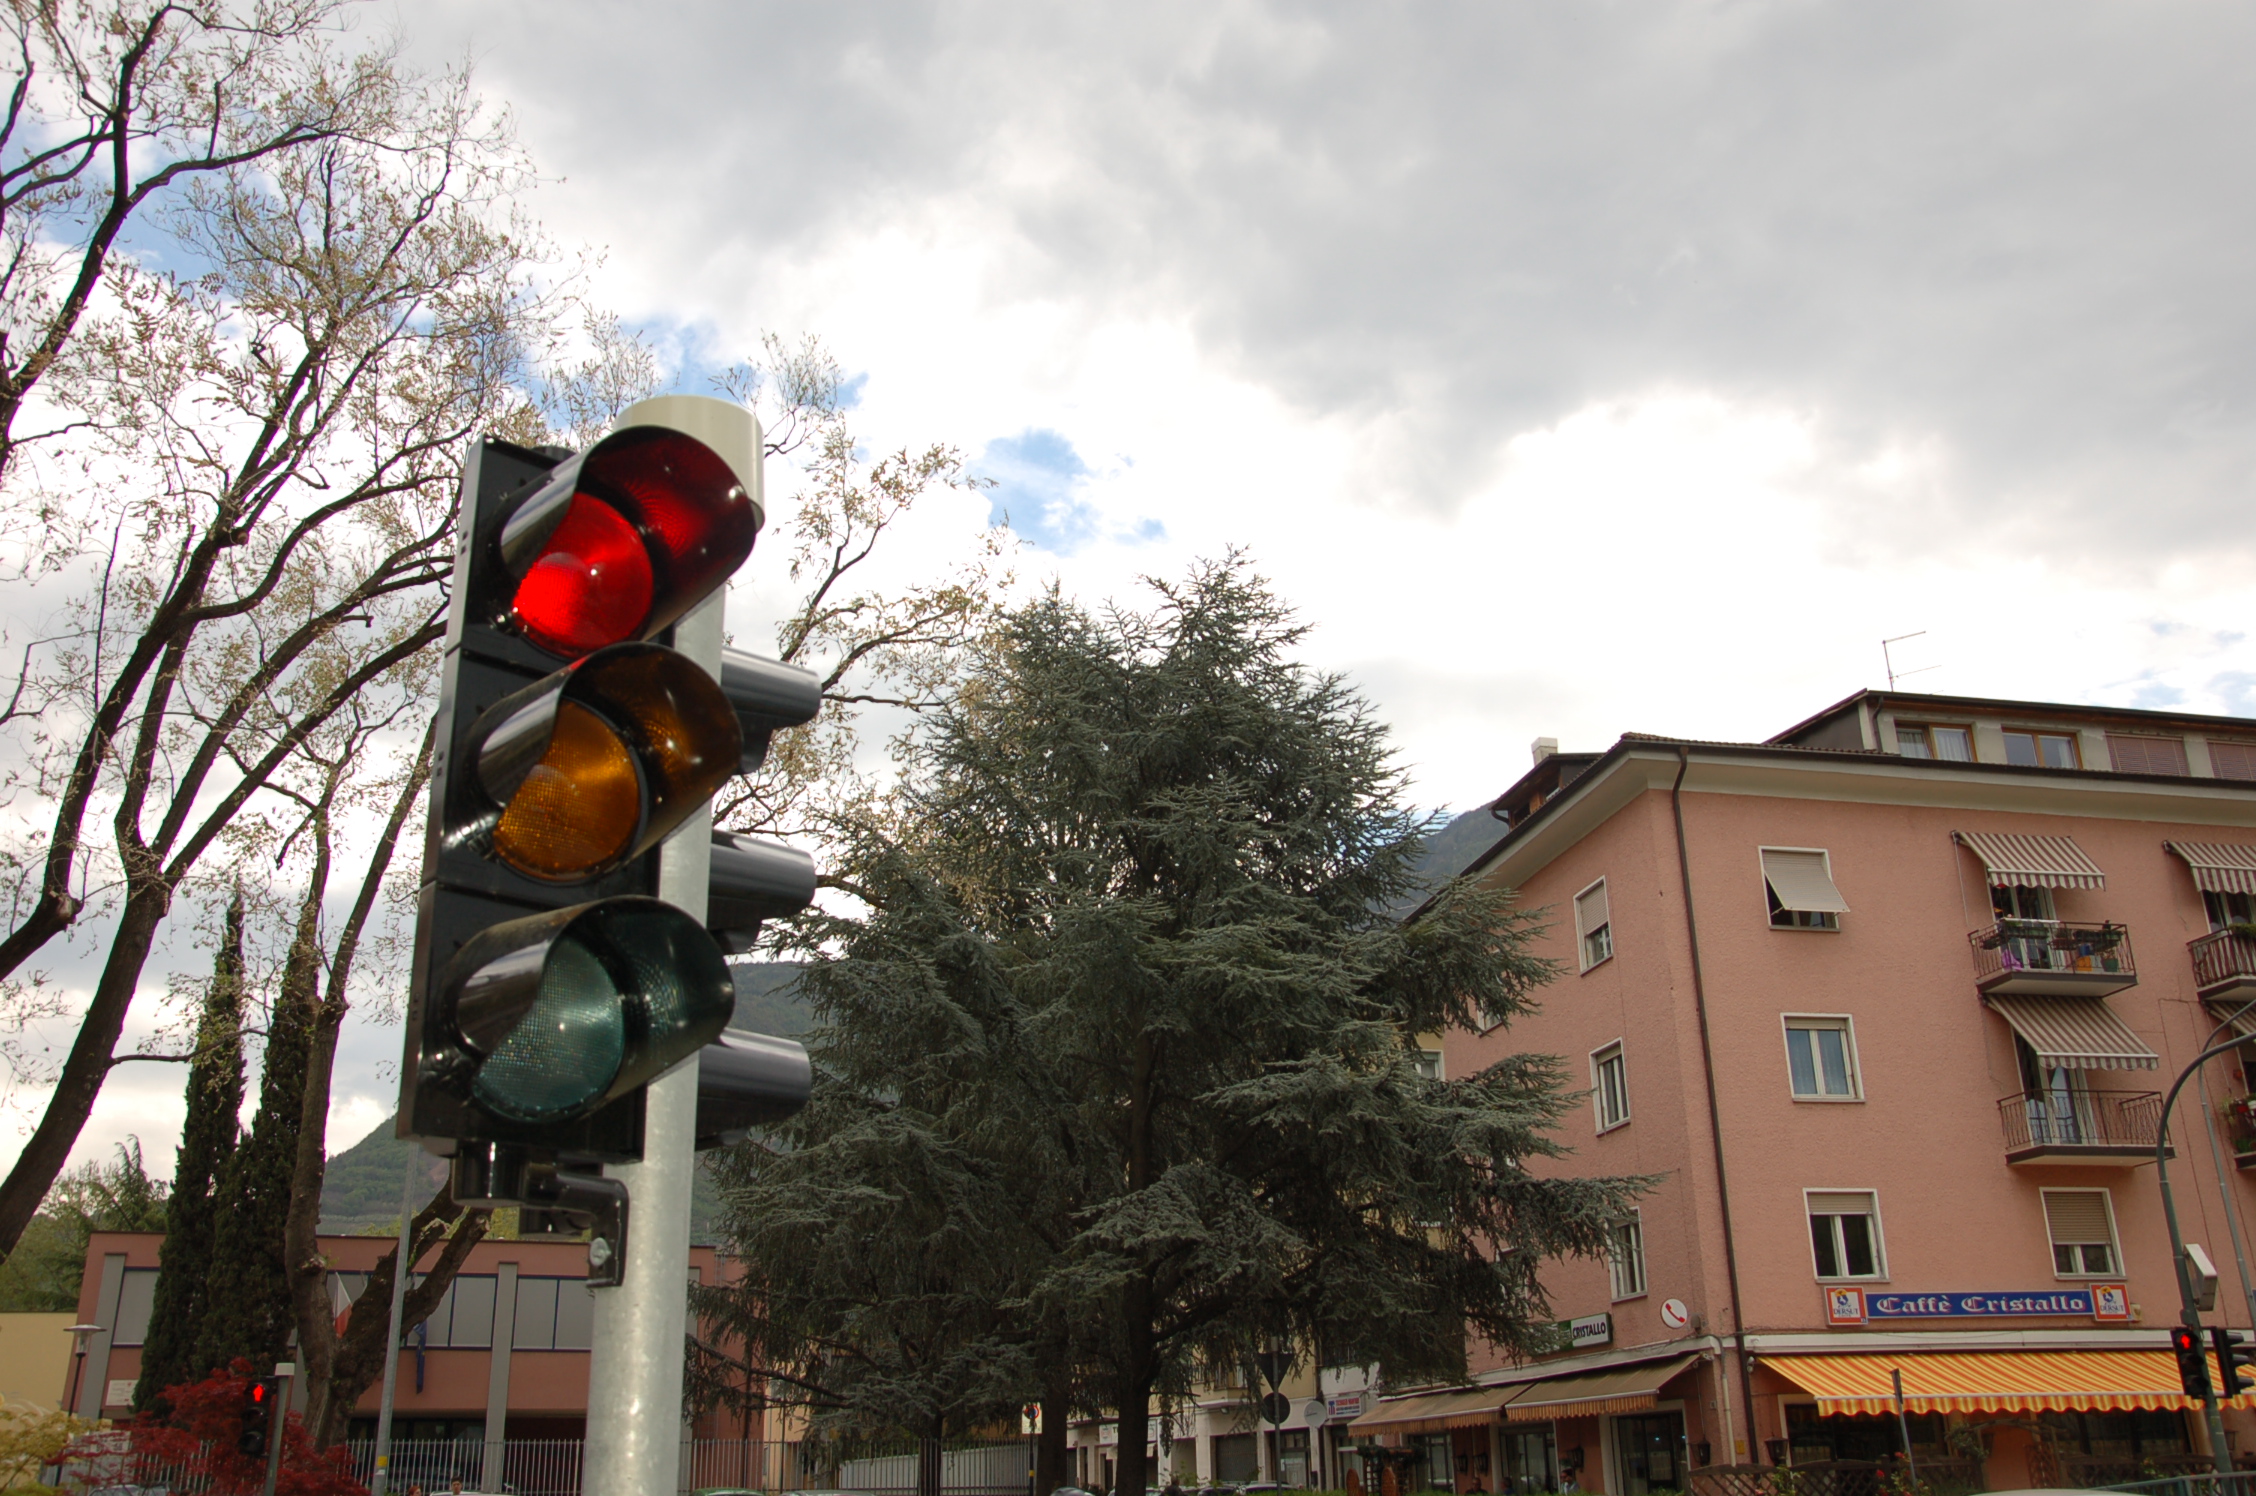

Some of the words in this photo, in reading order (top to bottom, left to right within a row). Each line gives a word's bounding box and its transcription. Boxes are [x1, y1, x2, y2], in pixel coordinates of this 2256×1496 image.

[1876, 1294, 1951, 1314] Caffè
[1961, 1295, 2085, 1314] Cristallo
[1572, 1322, 1606, 1339] CRISTALLO
